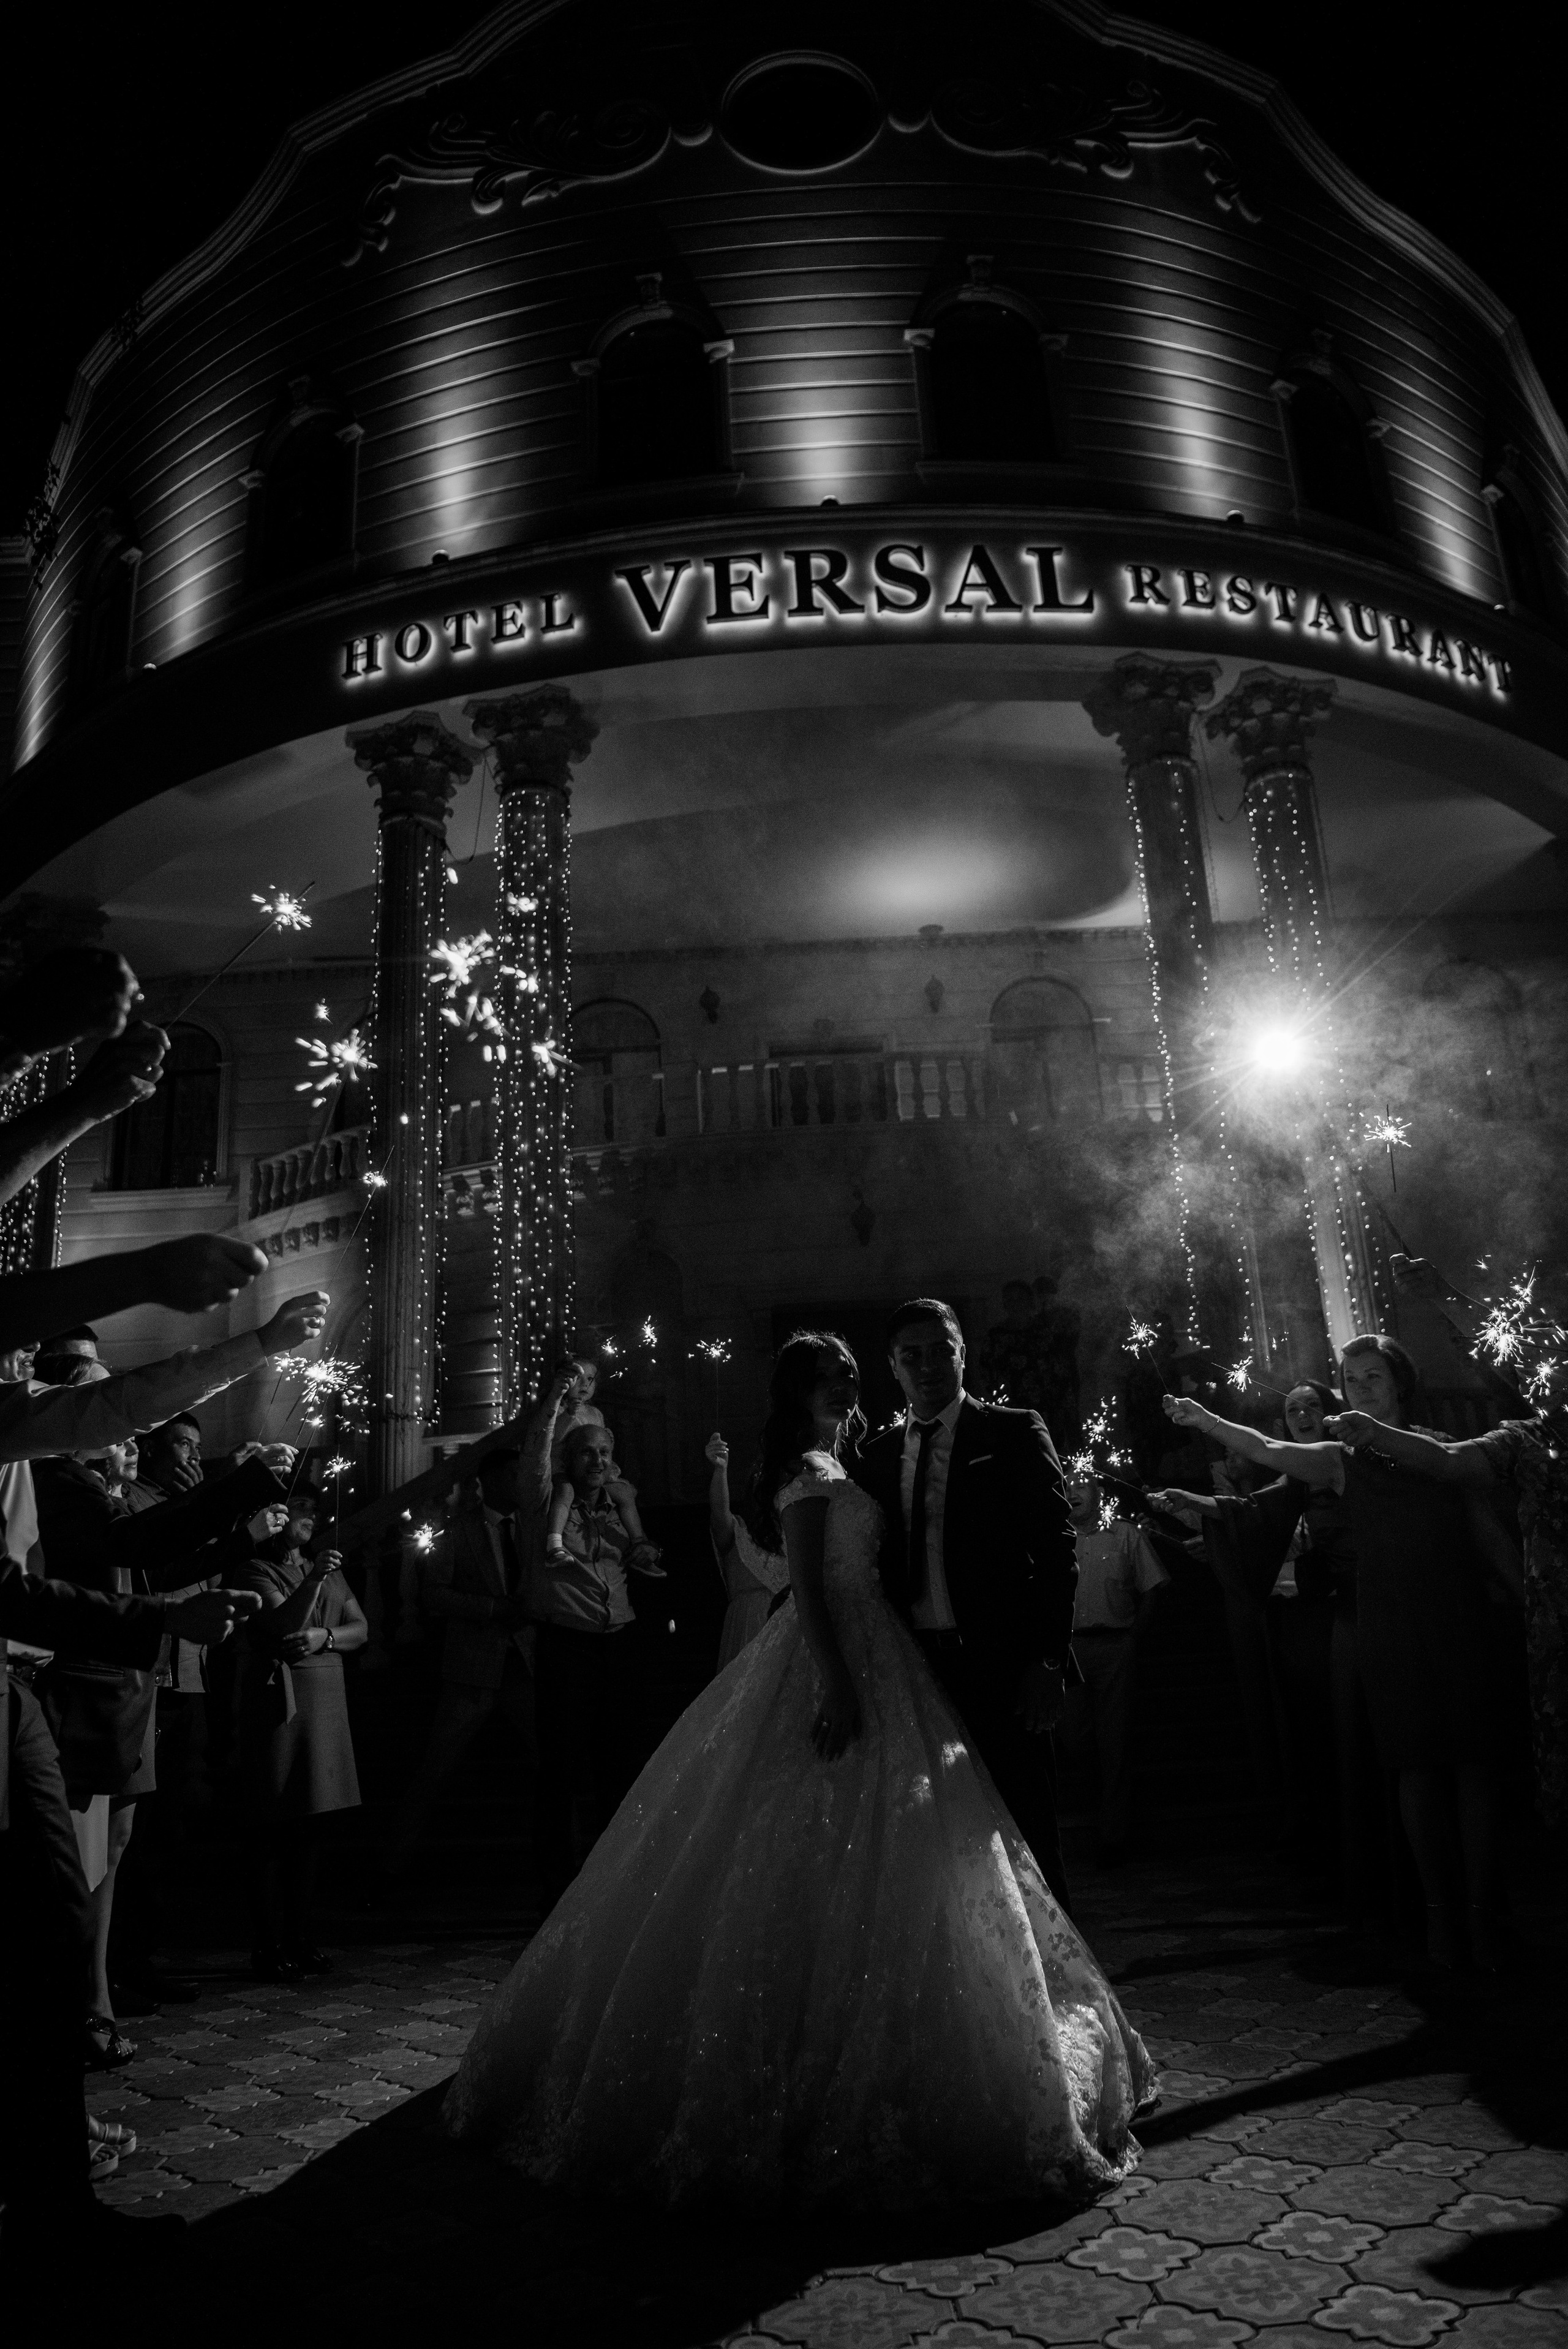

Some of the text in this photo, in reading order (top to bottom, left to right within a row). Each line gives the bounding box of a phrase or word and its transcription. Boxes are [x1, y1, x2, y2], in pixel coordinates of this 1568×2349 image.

[341, 543, 1512, 693] HOTEL VERSAL RESTAURANT
